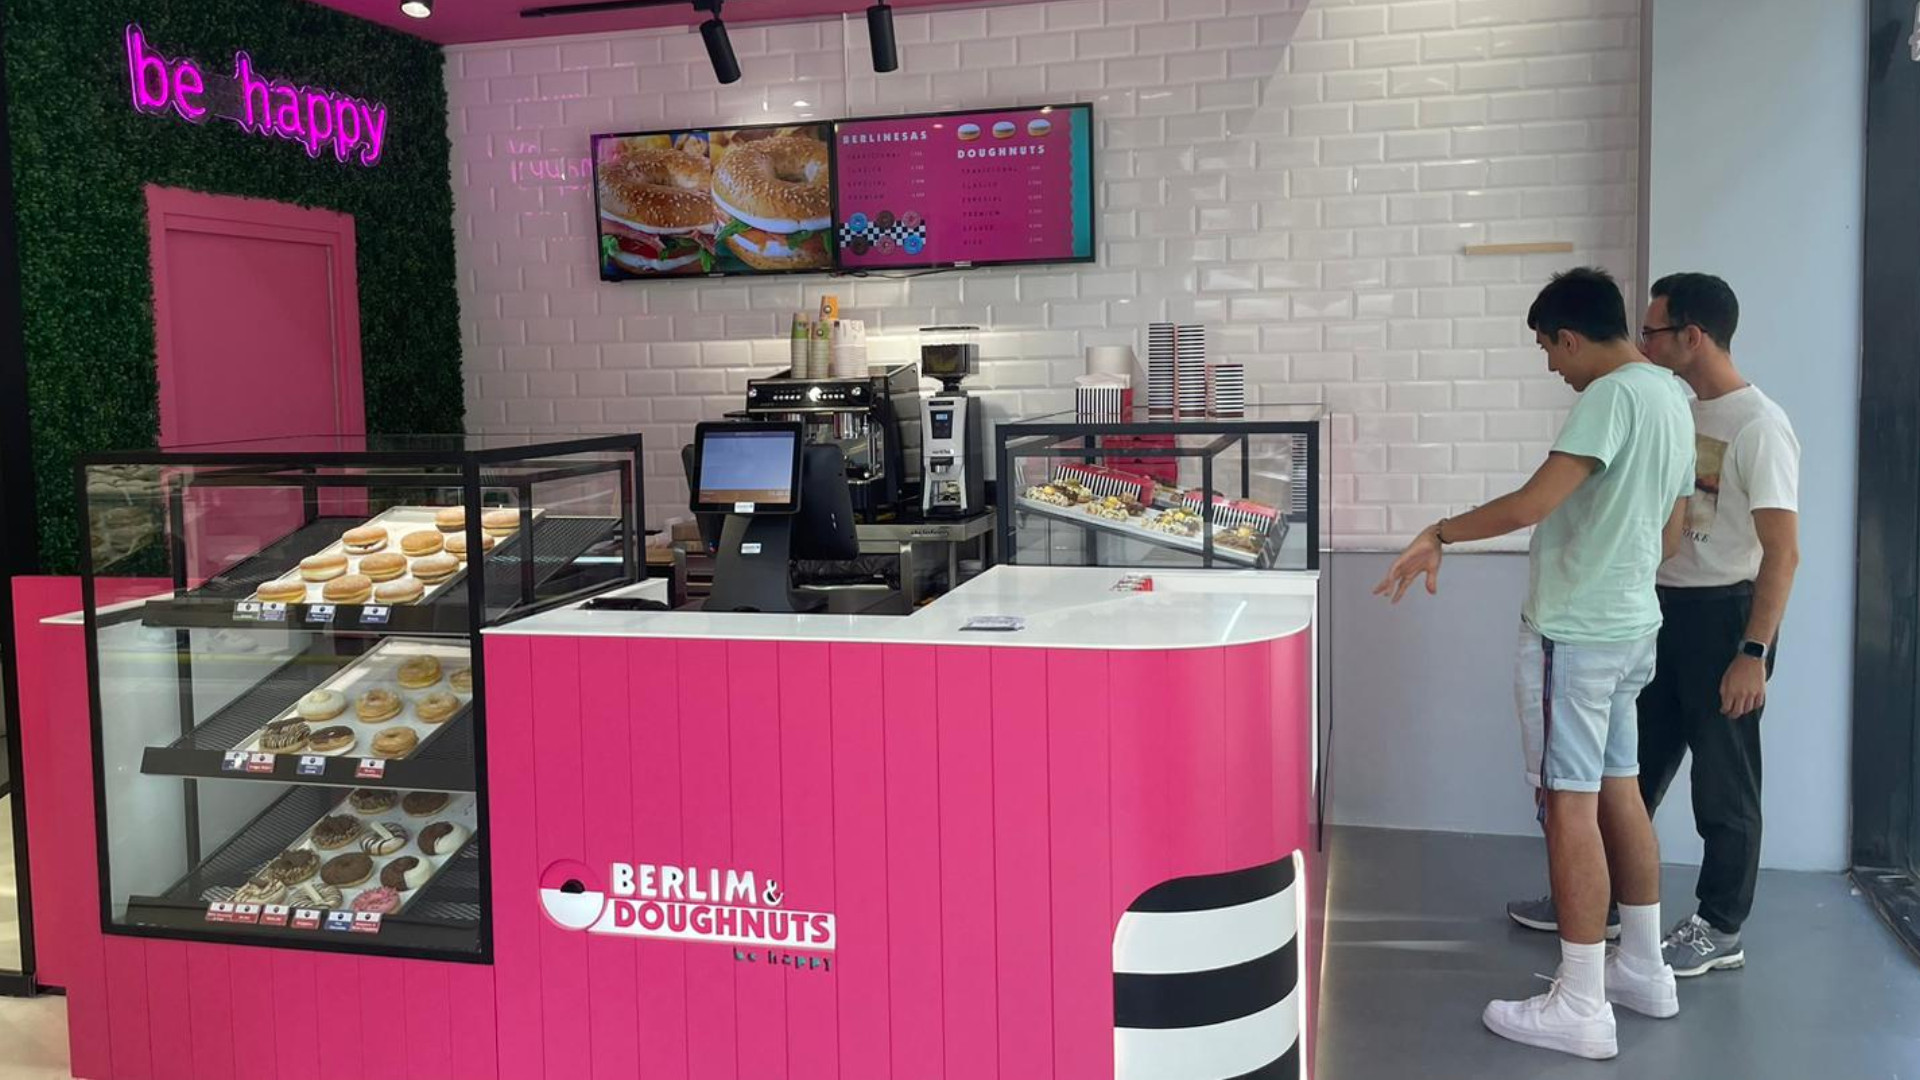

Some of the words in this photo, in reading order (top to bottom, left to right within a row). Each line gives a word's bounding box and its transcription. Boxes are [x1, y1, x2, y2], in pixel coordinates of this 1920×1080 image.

[130, 29, 206, 118] be
[240, 55, 386, 163] happy
[842, 130, 927, 145] BERLINESAS
[957, 144, 1046, 159] DOUGHNUTS
[611, 861, 757, 905] BERLIM
[762, 878, 784, 907] &
[613, 899, 831, 944] DOUGHNUTS
[733, 946, 756, 962] be
[767, 949, 832, 971] happy
